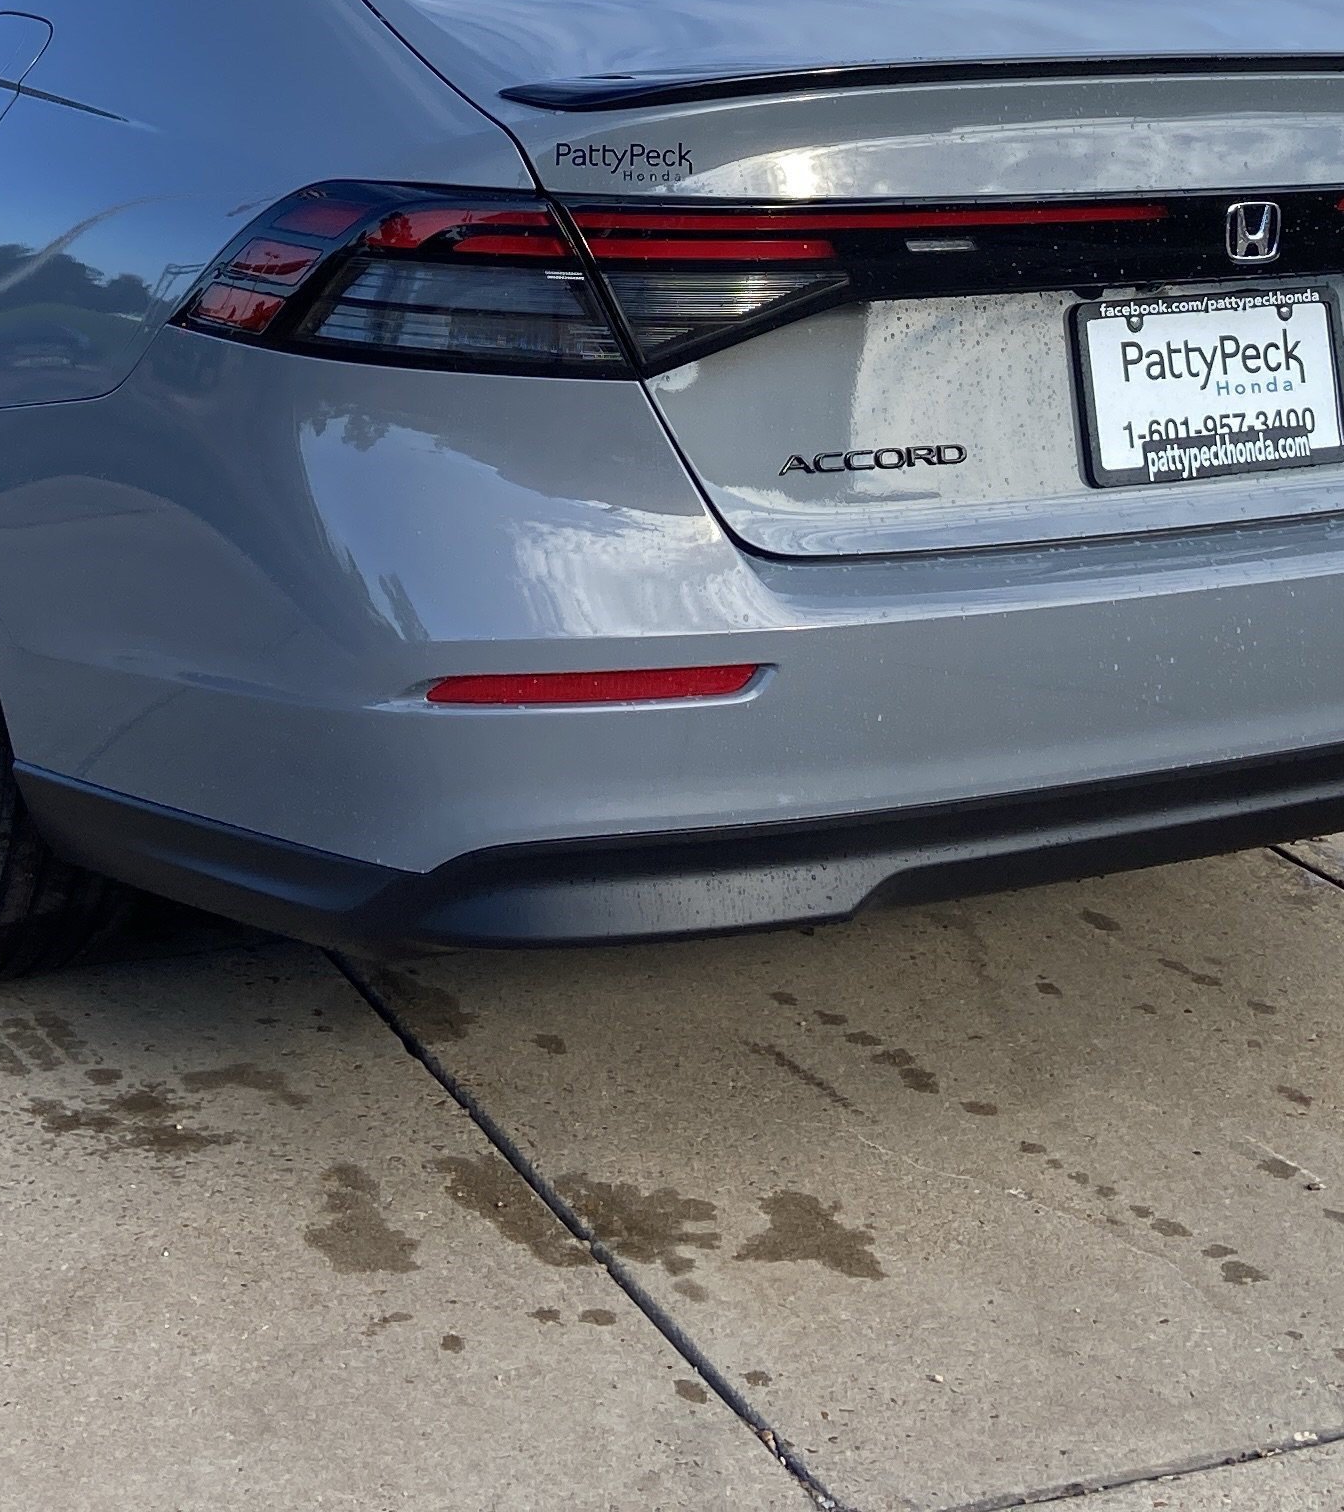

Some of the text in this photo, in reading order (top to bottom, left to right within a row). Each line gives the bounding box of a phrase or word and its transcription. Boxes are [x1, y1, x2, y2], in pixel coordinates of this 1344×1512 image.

[555, 142, 693, 175] PattyPeck
[623, 170, 682, 182] Honda
[1099, 289, 1320, 317] facebook.com/pattypeckhonda
[1120, 328, 1306, 390] PattyPeck
[1216, 375, 1294, 396] Honda
[778, 443, 968, 477] ACCORD
[1146, 432, 1311, 481] pattypeckhonda.com
